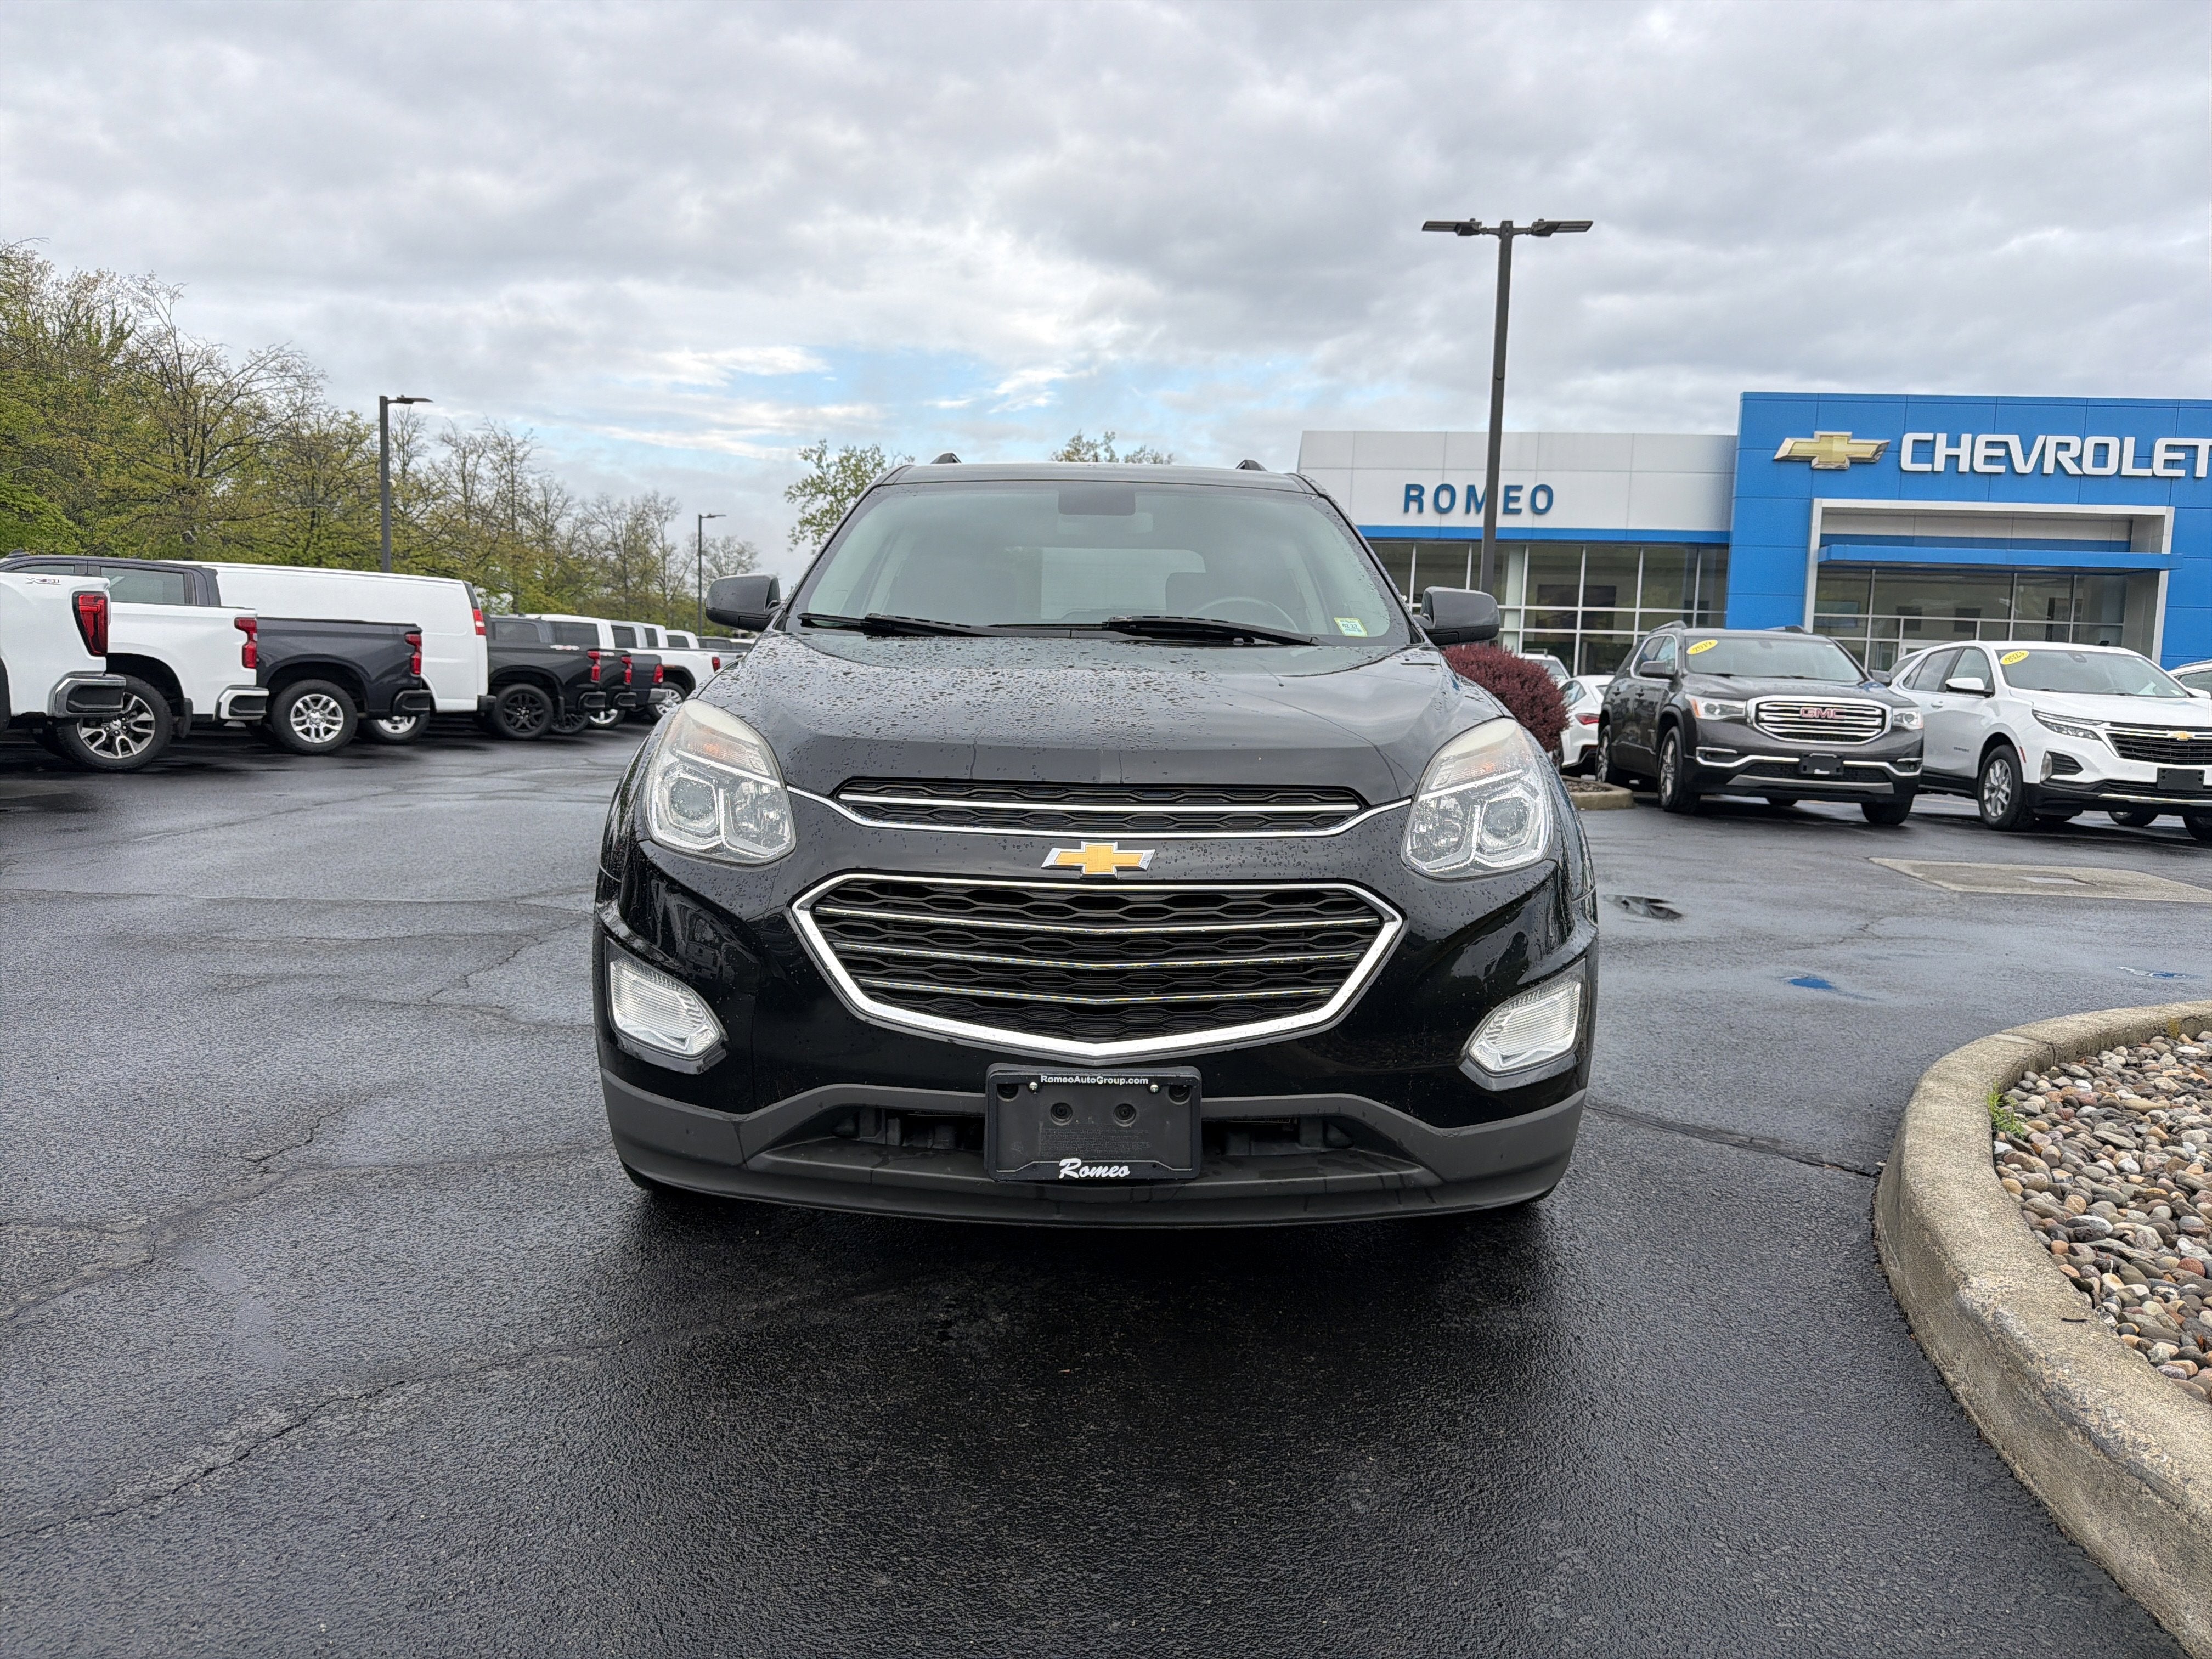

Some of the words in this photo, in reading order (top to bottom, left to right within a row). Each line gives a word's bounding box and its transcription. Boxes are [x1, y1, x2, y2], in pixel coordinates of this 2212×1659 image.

[1900, 432, 2212, 478] CHEVROLET
[1403, 483, 1554, 515] ROMEO
[1800, 707, 1846, 719] GMC
[1041, 1075, 1149, 1086] RomeoAutoGroup.com
[1059, 1158, 1131, 1179] Romeo
